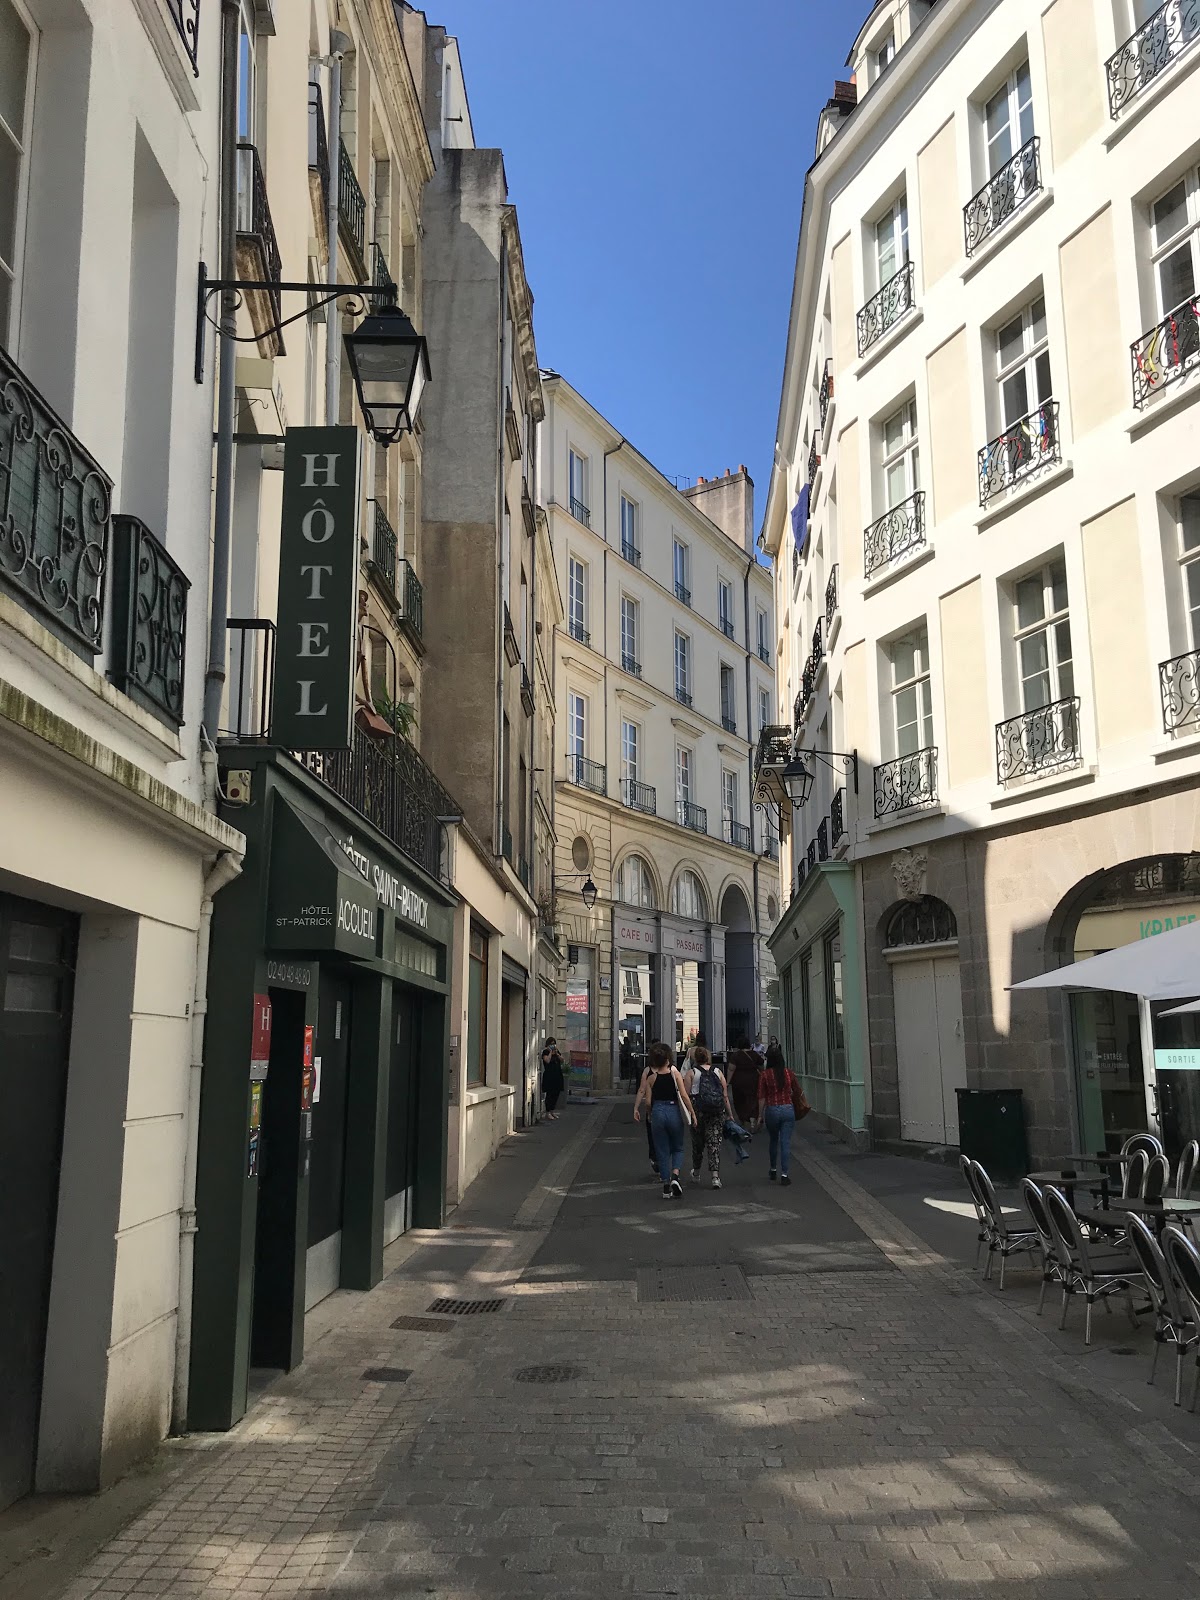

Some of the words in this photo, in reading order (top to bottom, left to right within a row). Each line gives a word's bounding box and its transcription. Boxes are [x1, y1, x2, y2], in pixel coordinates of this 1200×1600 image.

[295, 453, 342, 716] HÔTEL
[373, 865, 429, 929] SAINT-PATRICK
[301, 906, 333, 915] HÔTEL
[276, 917, 332, 927] ST-PATRICK
[337, 898, 375, 940] ACCUEIL
[645, 932, 654, 943] DU
[676, 939, 704, 952] PASSAGE
[267, 960, 277, 979] 02
[1167, 1055, 1196, 1064] SORTIE
